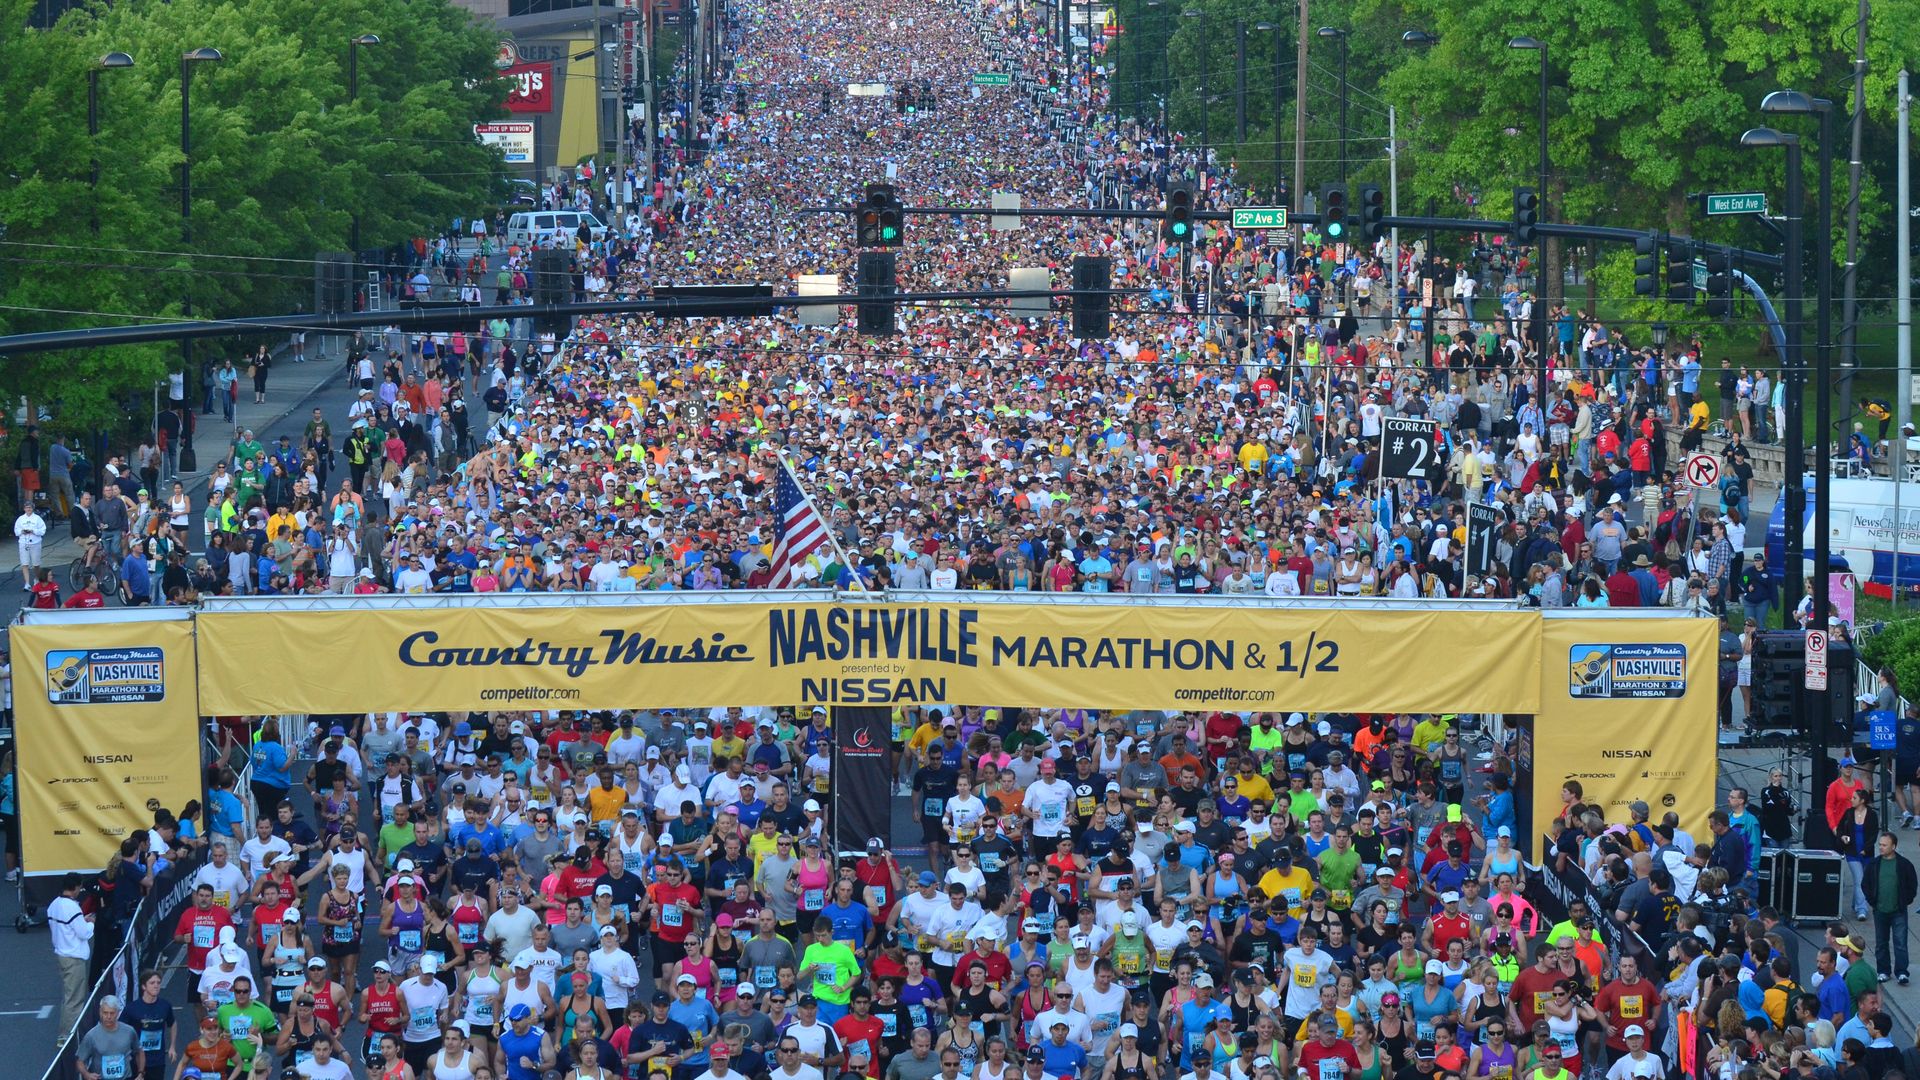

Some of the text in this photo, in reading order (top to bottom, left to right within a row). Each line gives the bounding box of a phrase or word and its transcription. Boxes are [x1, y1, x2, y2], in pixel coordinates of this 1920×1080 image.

[1715, 198, 1758, 210] West End Ave
[1236, 213, 1283, 224] 25th Ave S
[689, 406, 698, 418] 9
[1388, 420, 1434, 433] CORRAL
[1407, 437, 1429, 477] 2
[1470, 506, 1496, 523] CORRAL
[769, 607, 979, 668] NASHVILLE
[91, 650, 159, 660] Country Music
[399, 629, 755, 678] Country Music
[993, 631, 1340, 678] MARATHON & 1/2
[1614, 646, 1682, 656] Country Music
[94, 664, 159, 682] NASHVILLE
[842, 664, 906, 675] presented by
[1616, 660, 1681, 677] NASHVILLE
[91, 686, 139, 694] MARATHON
[480, 686, 580, 702] competitor.com
[801, 677, 946, 703] NISSAN
[1174, 687, 1275, 703] competitor.com
[111, 694, 145, 702] NISSAN
[1874, 725, 1889, 733] BUS
[1874, 733, 1895, 741] STOP
[83, 754, 133, 764] NISSAN
[1602, 750, 1652, 758] NISSAN
